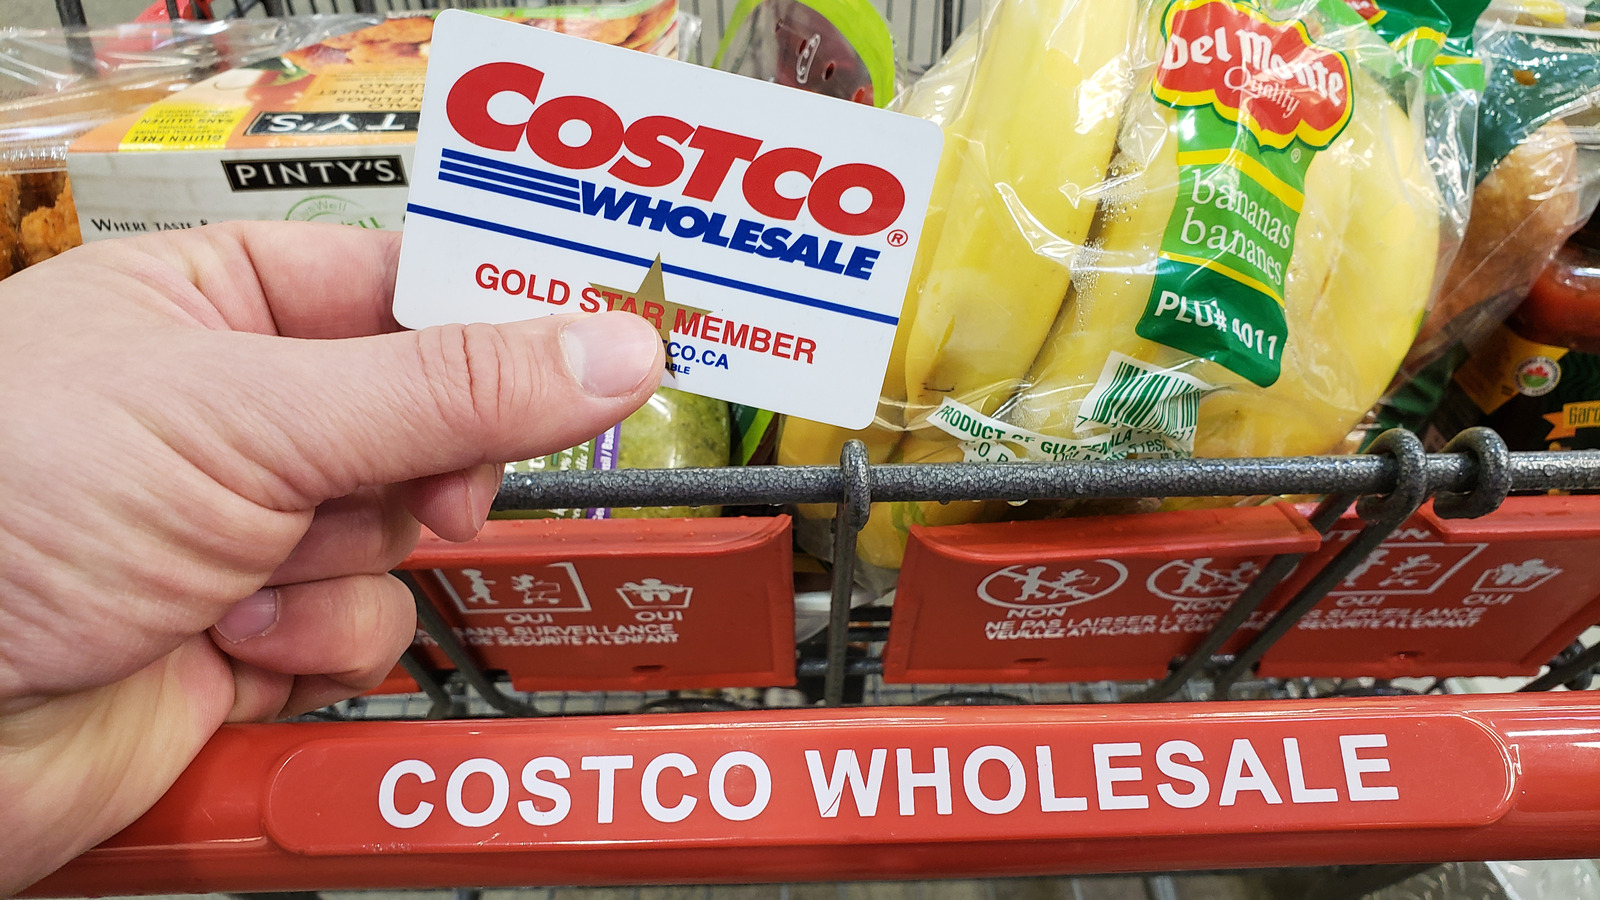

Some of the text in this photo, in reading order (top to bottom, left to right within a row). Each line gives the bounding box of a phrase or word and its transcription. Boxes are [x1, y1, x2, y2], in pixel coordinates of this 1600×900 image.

[1162, 26, 1344, 107] Del Monte
[1224, 65, 1300, 119] Quality
[268, 113, 406, 132] TY'S
[446, 61, 905, 236] COSTCO
[236, 159, 398, 187] PINTY'S
[579, 180, 881, 281] WHOLESALE
[1191, 169, 1291, 249] bananas
[1180, 207, 1282, 286] bananes
[475, 263, 570, 306] GOLD
[673, 308, 817, 364] MEMBER
[1154, 290, 1278, 360] PLU# 4011
[935, 405, 1006, 440] PRODUCT
[505, 613, 553, 624] OUI
[512, 623, 676, 637] SURVEILLANCE
[635, 611, 683, 622] OUI
[985, 620, 1015, 632] NE
[1018, 619, 1061, 631] PAS
[1067, 615, 1158, 628] LAISSER
[985, 628, 1066, 641] VEUILLEZ
[1067, 625, 1156, 637] ATTACHER
[1007, 606, 1067, 618] NON
[380, 734, 1398, 828] COSTCO WHOLESALE
